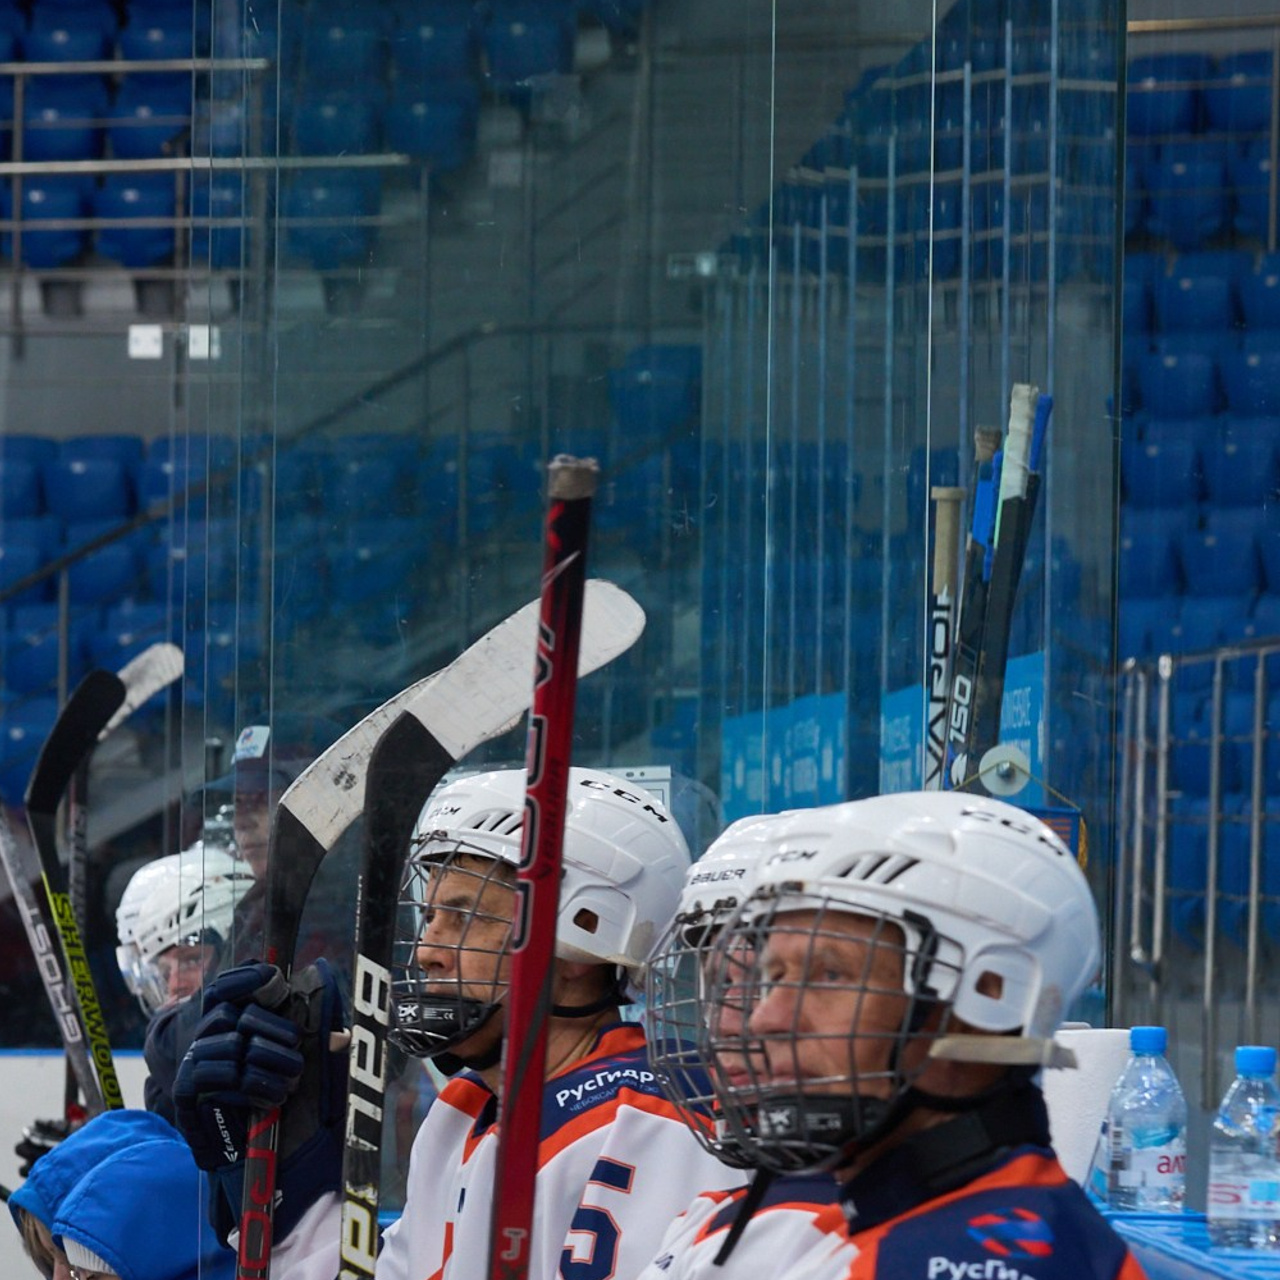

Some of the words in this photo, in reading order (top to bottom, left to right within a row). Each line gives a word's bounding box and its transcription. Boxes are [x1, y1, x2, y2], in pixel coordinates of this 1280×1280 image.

[950, 674, 972, 743] 150
[580, 779, 669, 823] CCM
[24, 906, 82, 1043] GHOST
[214, 1107, 236, 1152] EASTON
